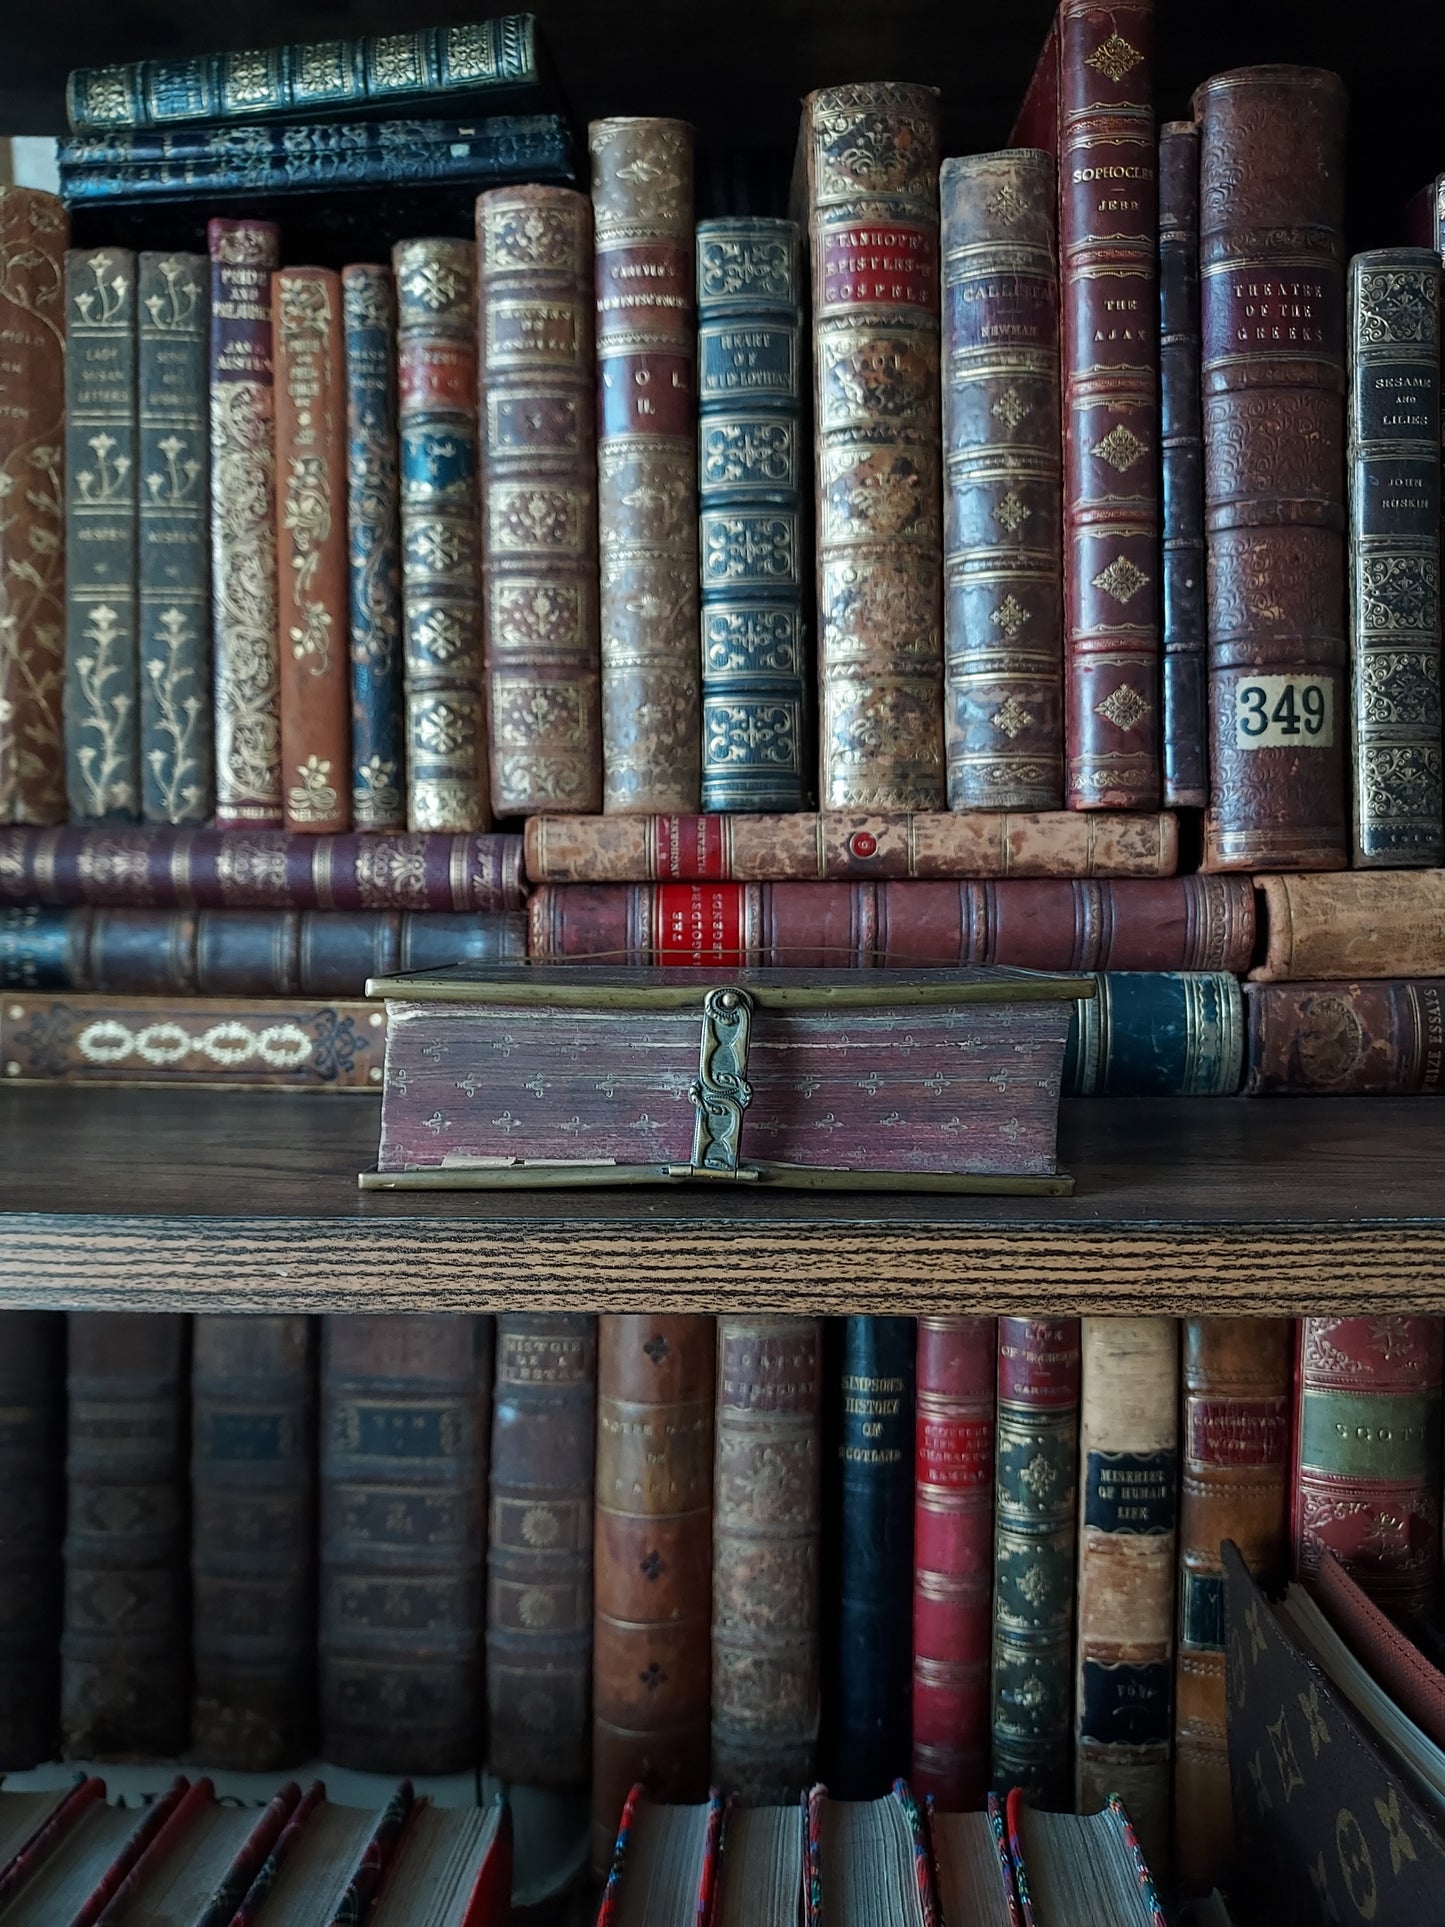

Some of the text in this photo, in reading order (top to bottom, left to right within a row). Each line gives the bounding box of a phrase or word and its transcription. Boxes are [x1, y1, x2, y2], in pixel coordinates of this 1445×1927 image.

[1073, 166, 1153, 184] SOPHOCLES
[1098, 200, 1140, 211] JEBB
[826, 282, 929, 303] GOSPELS
[1233, 283, 1322, 298] THEATRE
[1104, 300, 1137, 311] THE
[1245, 304, 1311, 317] OF THE
[981, 324, 1037, 338] NEWMAN
[1094, 329, 1147, 341] AJAX
[1237, 326, 1322, 340] GREEKS
[721, 333, 771, 350] HEART
[733, 352, 757, 367] OF
[1375, 377, 1431, 389] SESAME
[1395, 395, 1416, 404] AND
[1383, 415, 1428, 425] LILIES
[1388, 478, 1422, 488] JOHN
[1382, 498, 1428, 509] RUSKIN
[1240, 684, 1325, 737] 349
[288, 808, 342, 823] NELSON
[672, 911, 683, 942] THE
[712, 892, 723, 961] LEGENDS
[1423, 988, 1443, 1044] ESSAYS
[1001, 1345, 1018, 1359] OF
[845, 1397, 899, 1415] HISTORY
[1098, 1484, 1115, 1499] OF
